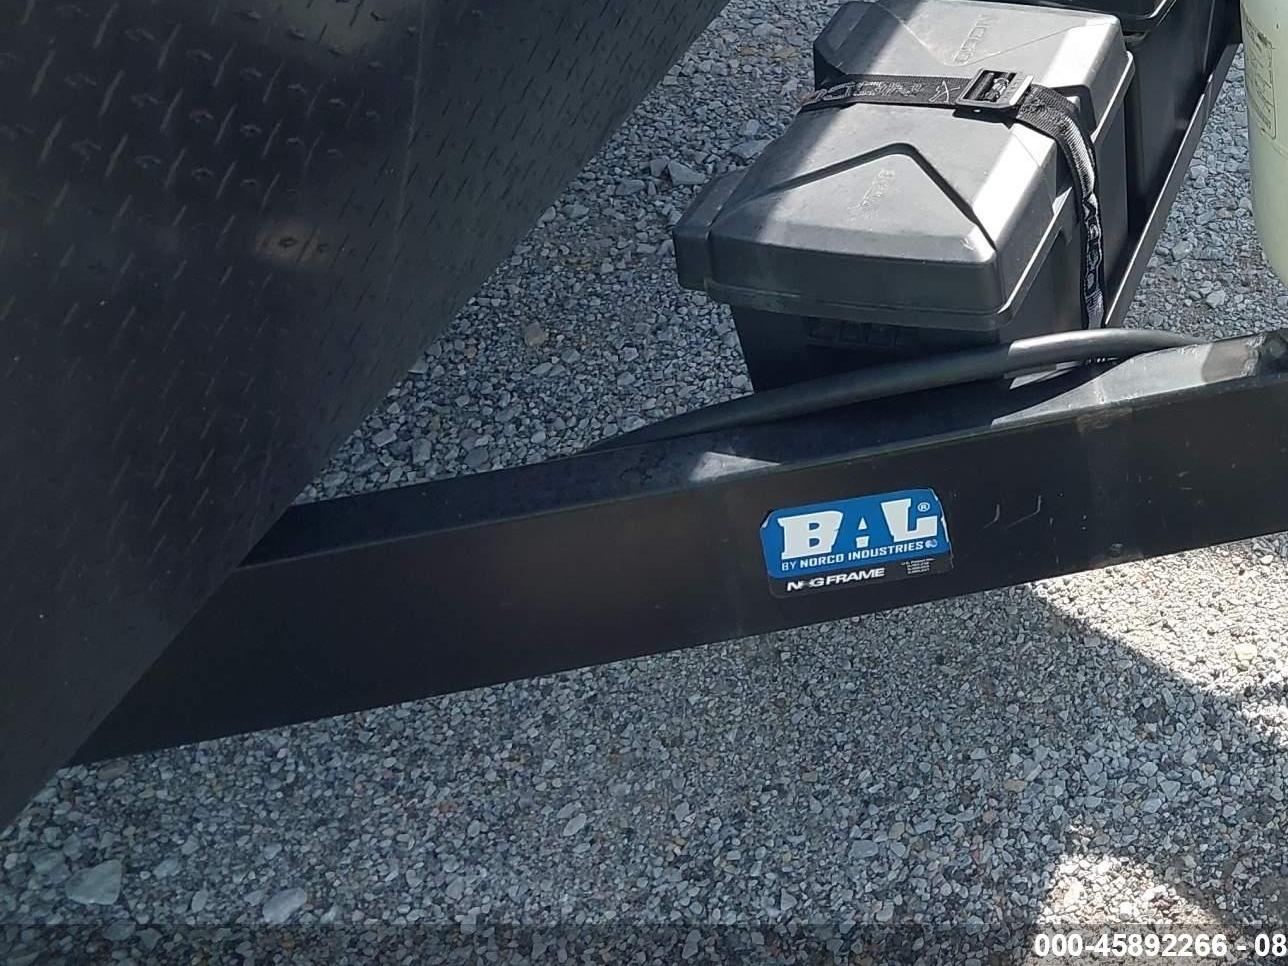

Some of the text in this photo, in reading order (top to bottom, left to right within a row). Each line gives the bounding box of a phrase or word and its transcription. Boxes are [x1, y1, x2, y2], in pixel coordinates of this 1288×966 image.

[777, 498, 938, 560] BAL
[781, 541, 924, 571] BY NORCO INDUSTRIES
[826, 567, 885, 585] FRAME
